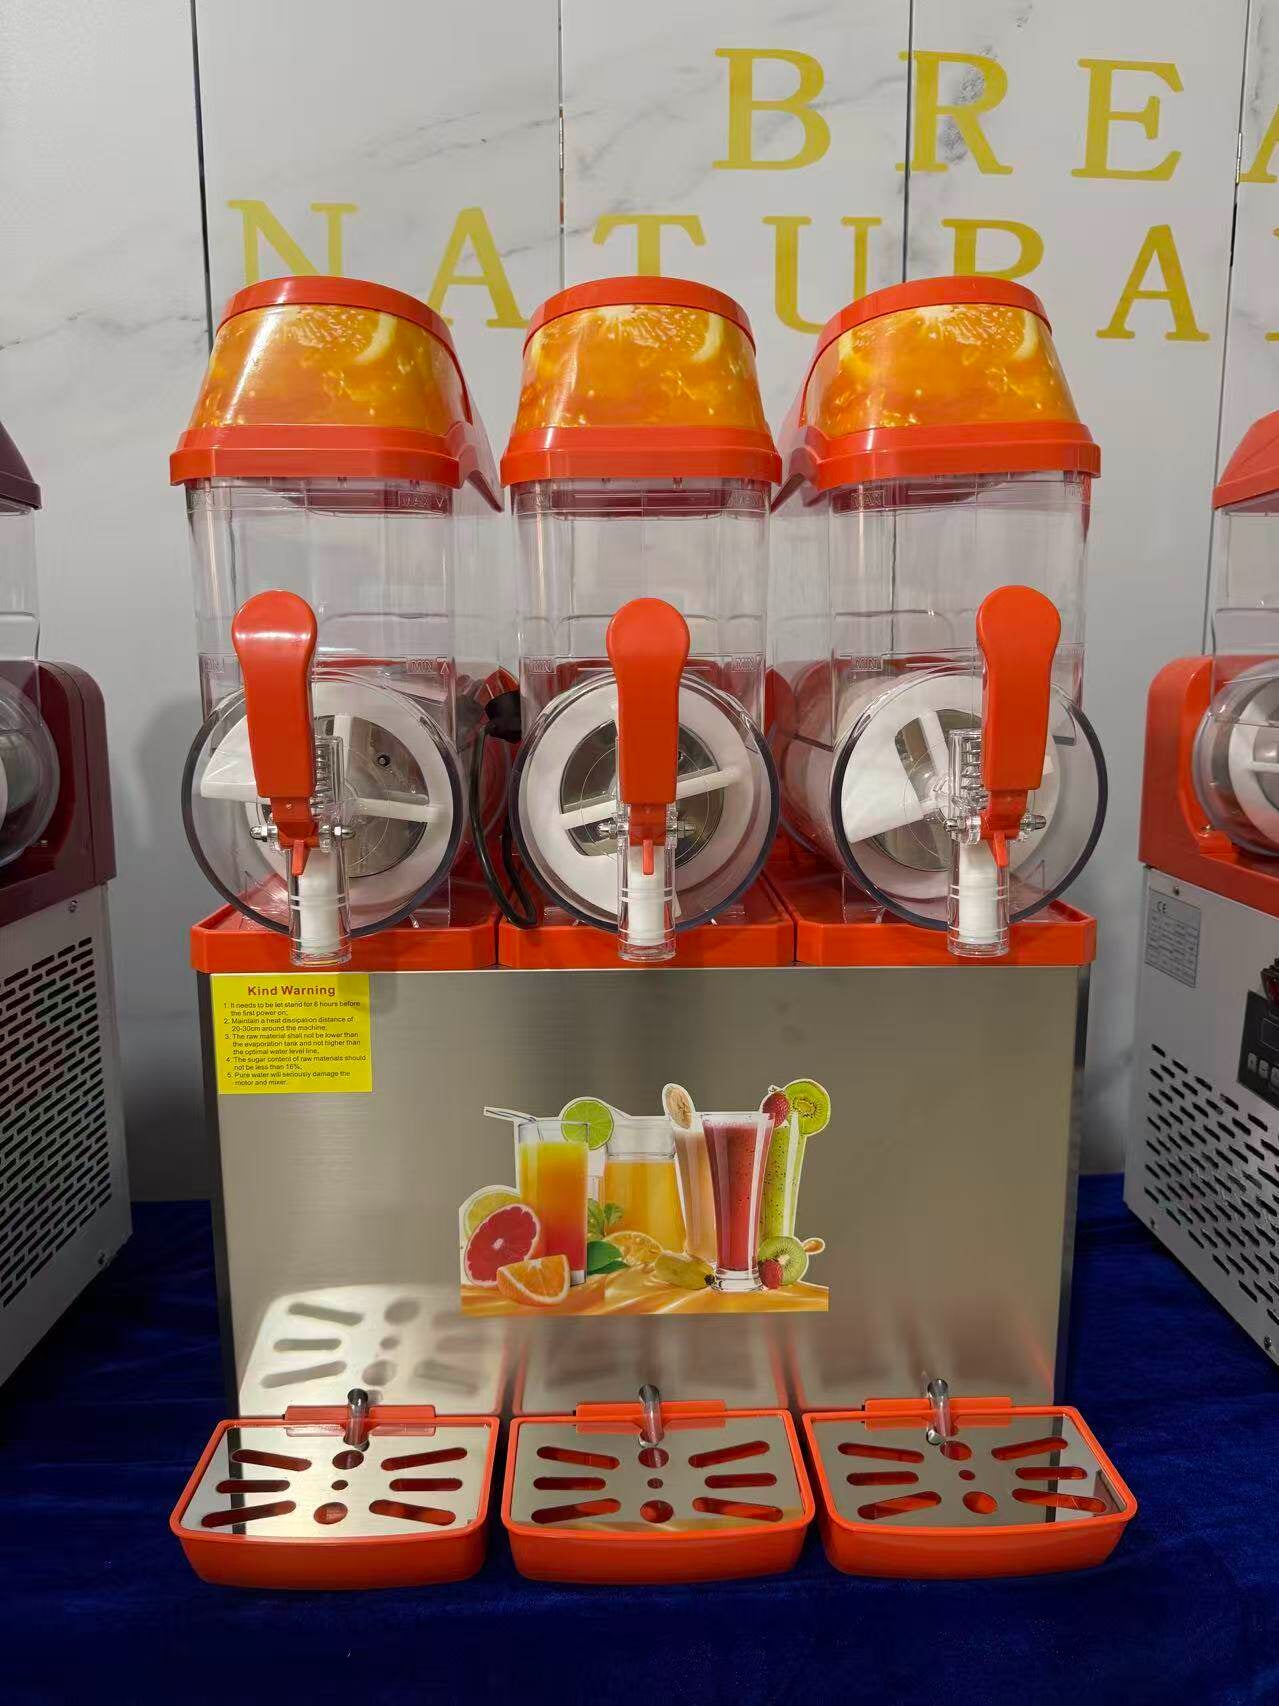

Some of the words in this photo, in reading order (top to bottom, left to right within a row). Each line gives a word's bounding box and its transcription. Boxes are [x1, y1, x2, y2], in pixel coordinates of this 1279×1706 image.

[227, 199, 1279, 341] NATURA
[248, 986, 278, 996] Kind
[281, 985, 336, 997] Warning
